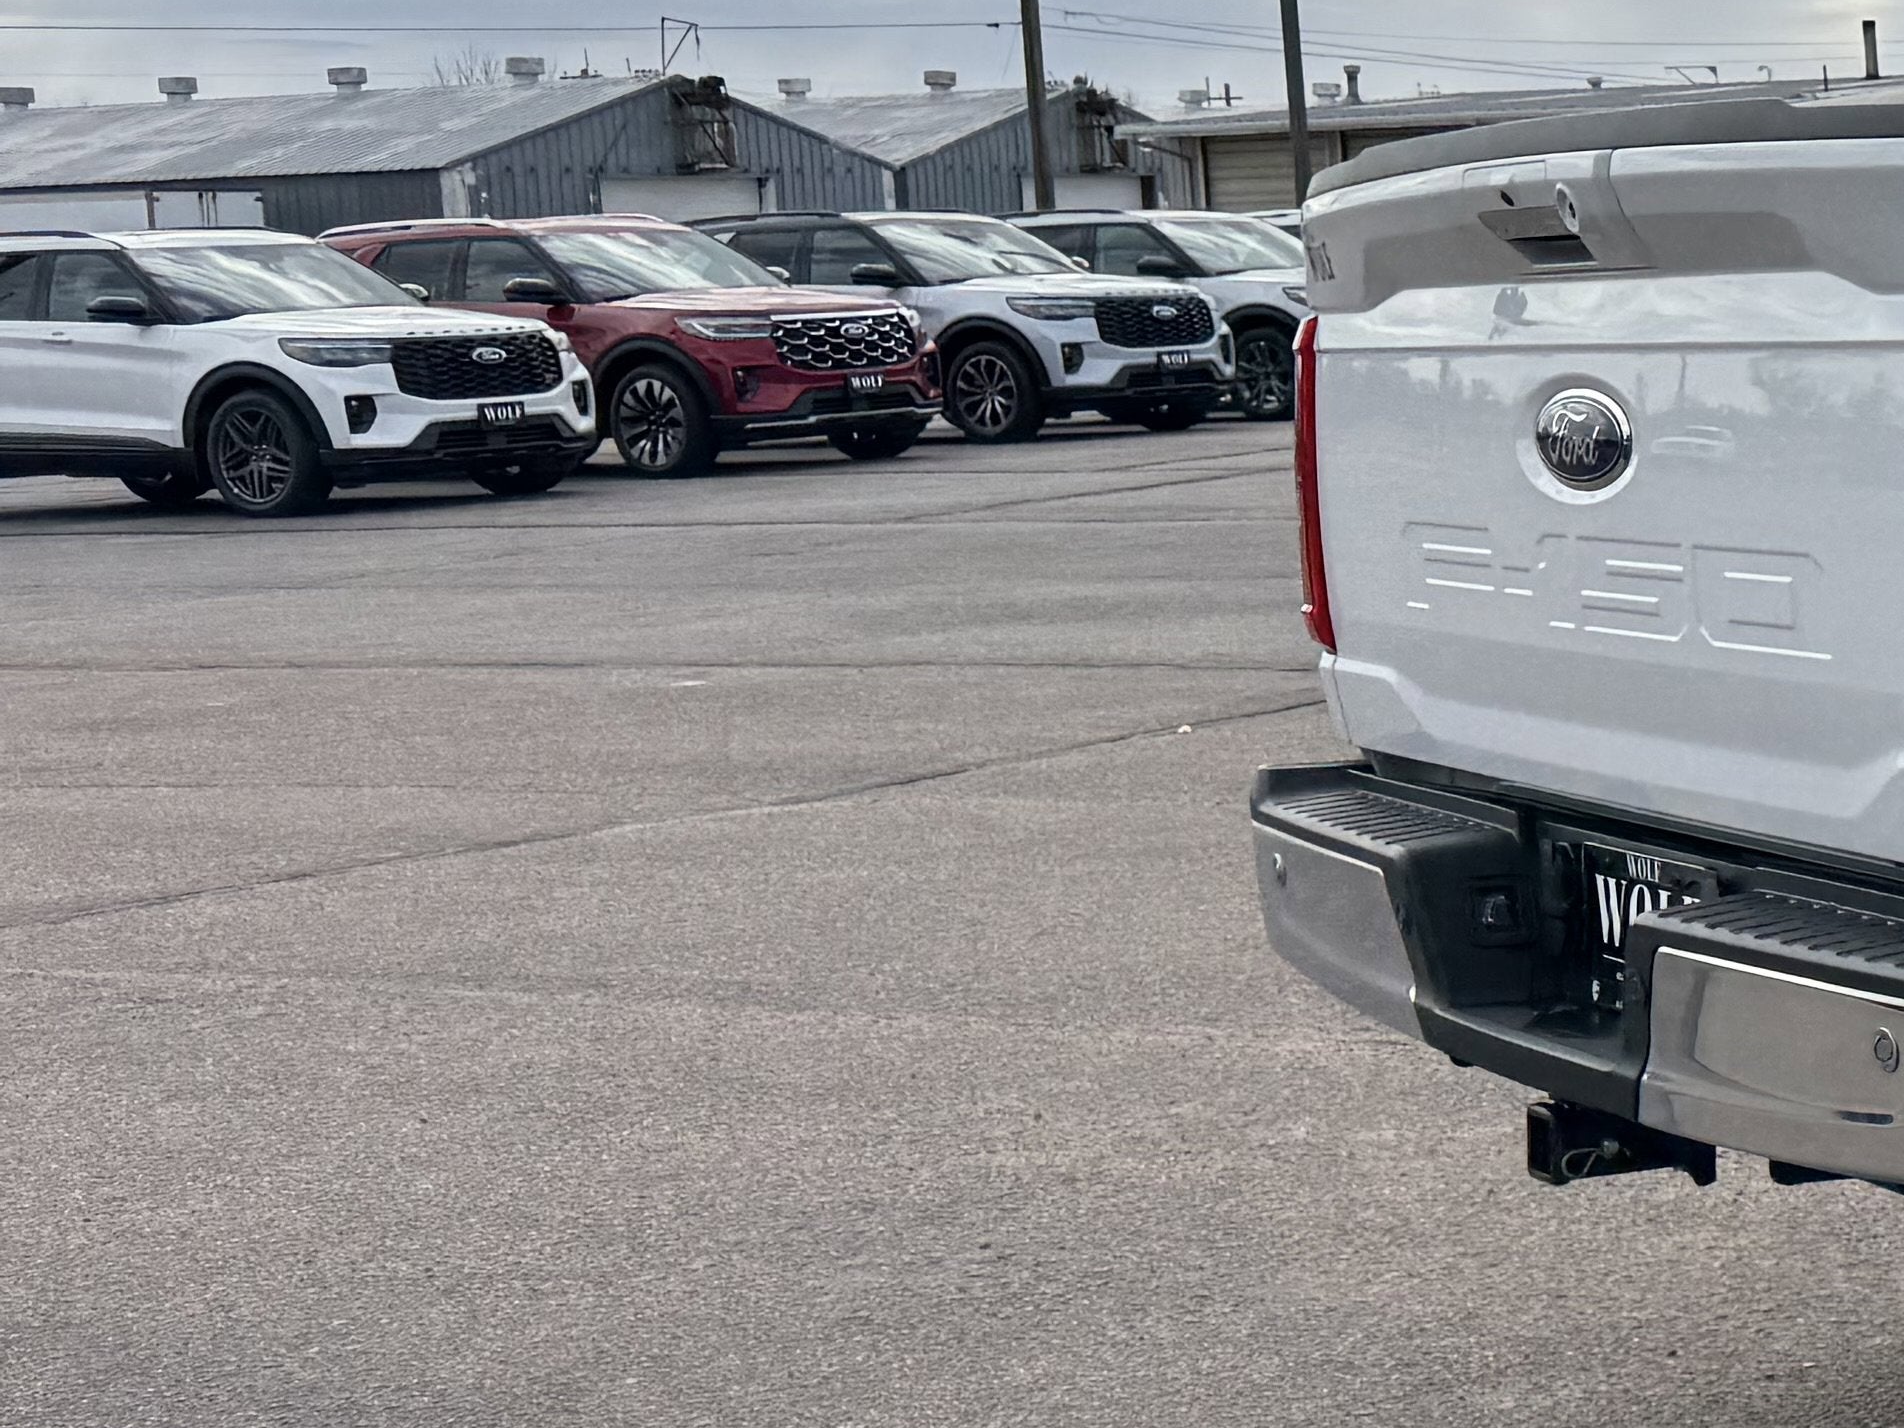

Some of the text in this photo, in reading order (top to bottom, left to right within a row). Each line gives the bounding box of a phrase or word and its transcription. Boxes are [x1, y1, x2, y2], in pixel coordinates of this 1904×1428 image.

[484, 403, 522, 422] WOLF
[1547, 409, 1600, 466] Ford
[1626, 853, 1662, 883] WOLF
